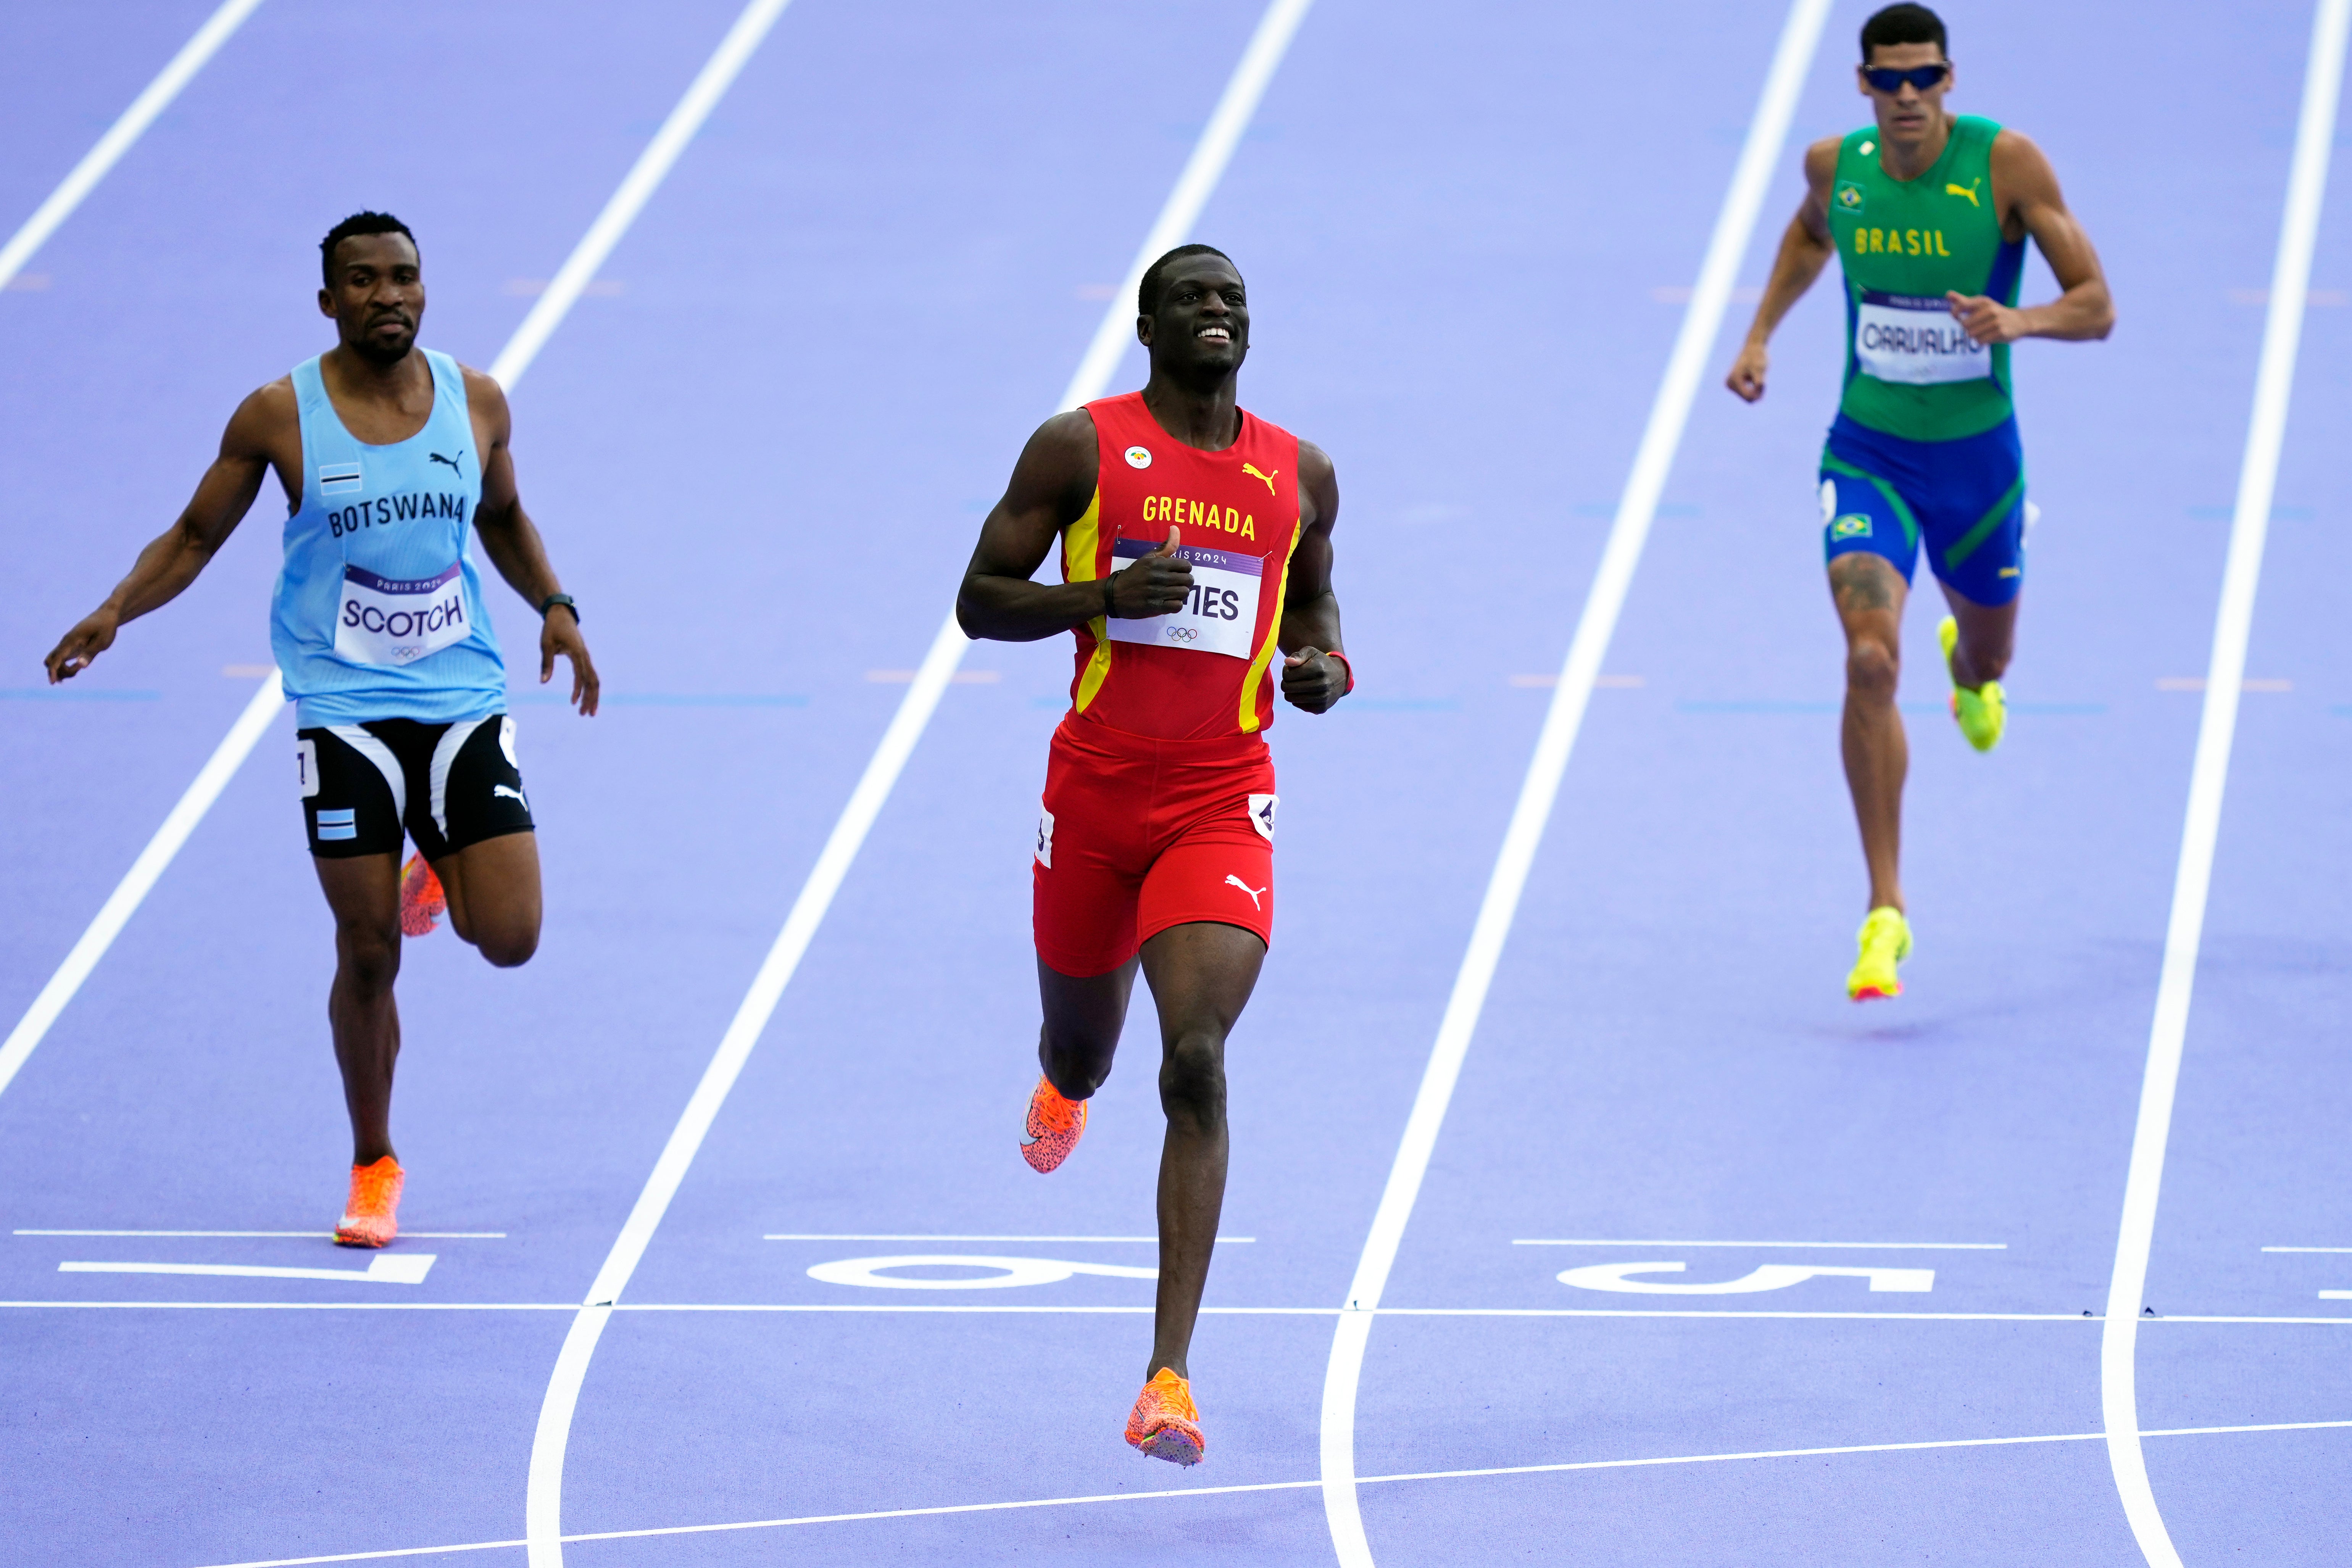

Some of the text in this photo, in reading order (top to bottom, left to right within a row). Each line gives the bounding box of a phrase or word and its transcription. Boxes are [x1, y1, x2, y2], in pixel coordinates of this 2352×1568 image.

[1855, 228, 1950, 256] BRASIL
[329, 492, 464, 537] BOTSWANA
[1143, 496, 1255, 541] GRENADA
[1195, 552, 1227, 565] 2024
[377, 579, 411, 591] PARIS
[342, 595, 463, 638] SCOTCH
[58, 1254, 437, 1284] 7
[806, 1254, 1159, 1289] 6
[1556, 1261, 1935, 1294] 5
